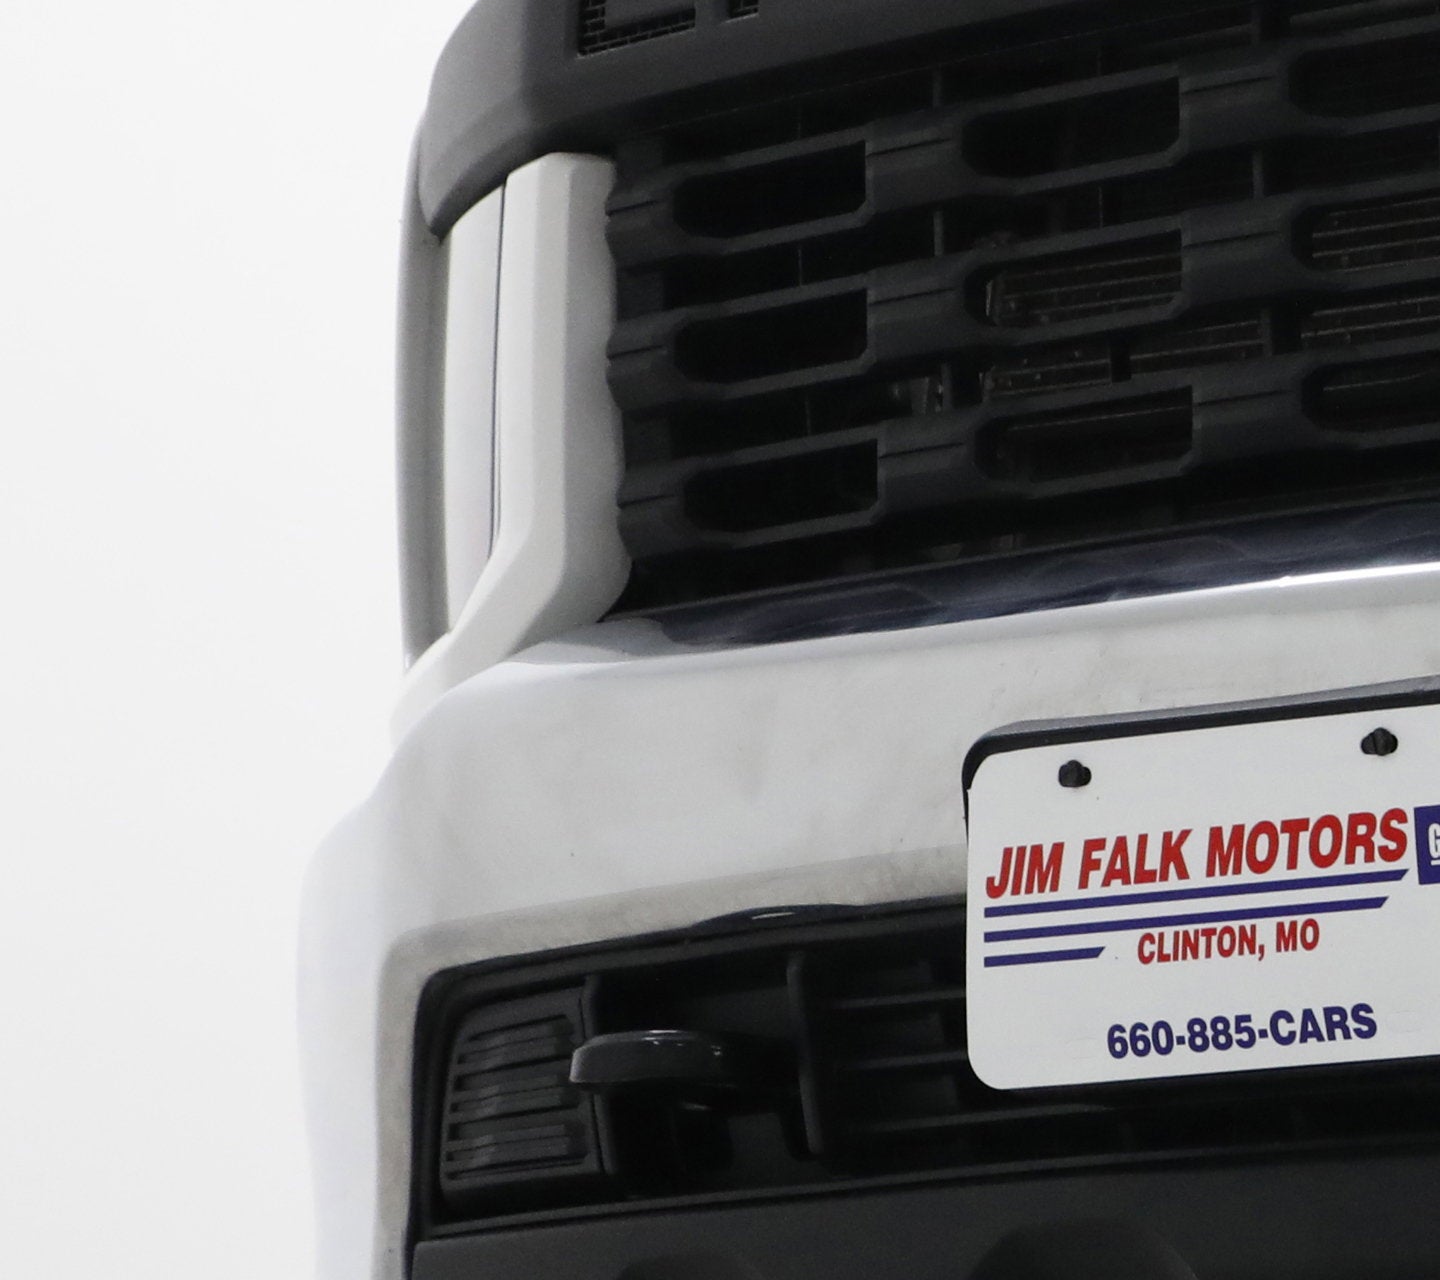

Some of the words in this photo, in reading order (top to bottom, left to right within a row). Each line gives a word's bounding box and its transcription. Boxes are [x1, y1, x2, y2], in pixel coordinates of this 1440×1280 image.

[984, 841, 1065, 900] JIM
[1077, 829, 1193, 892] FALK
[1205, 807, 1409, 878] MOTORS
[1136, 922, 1266, 965] CLINTON,
[1275, 918, 1321, 953] MO
[1106, 1003, 1378, 1059] 660-885-CARS
